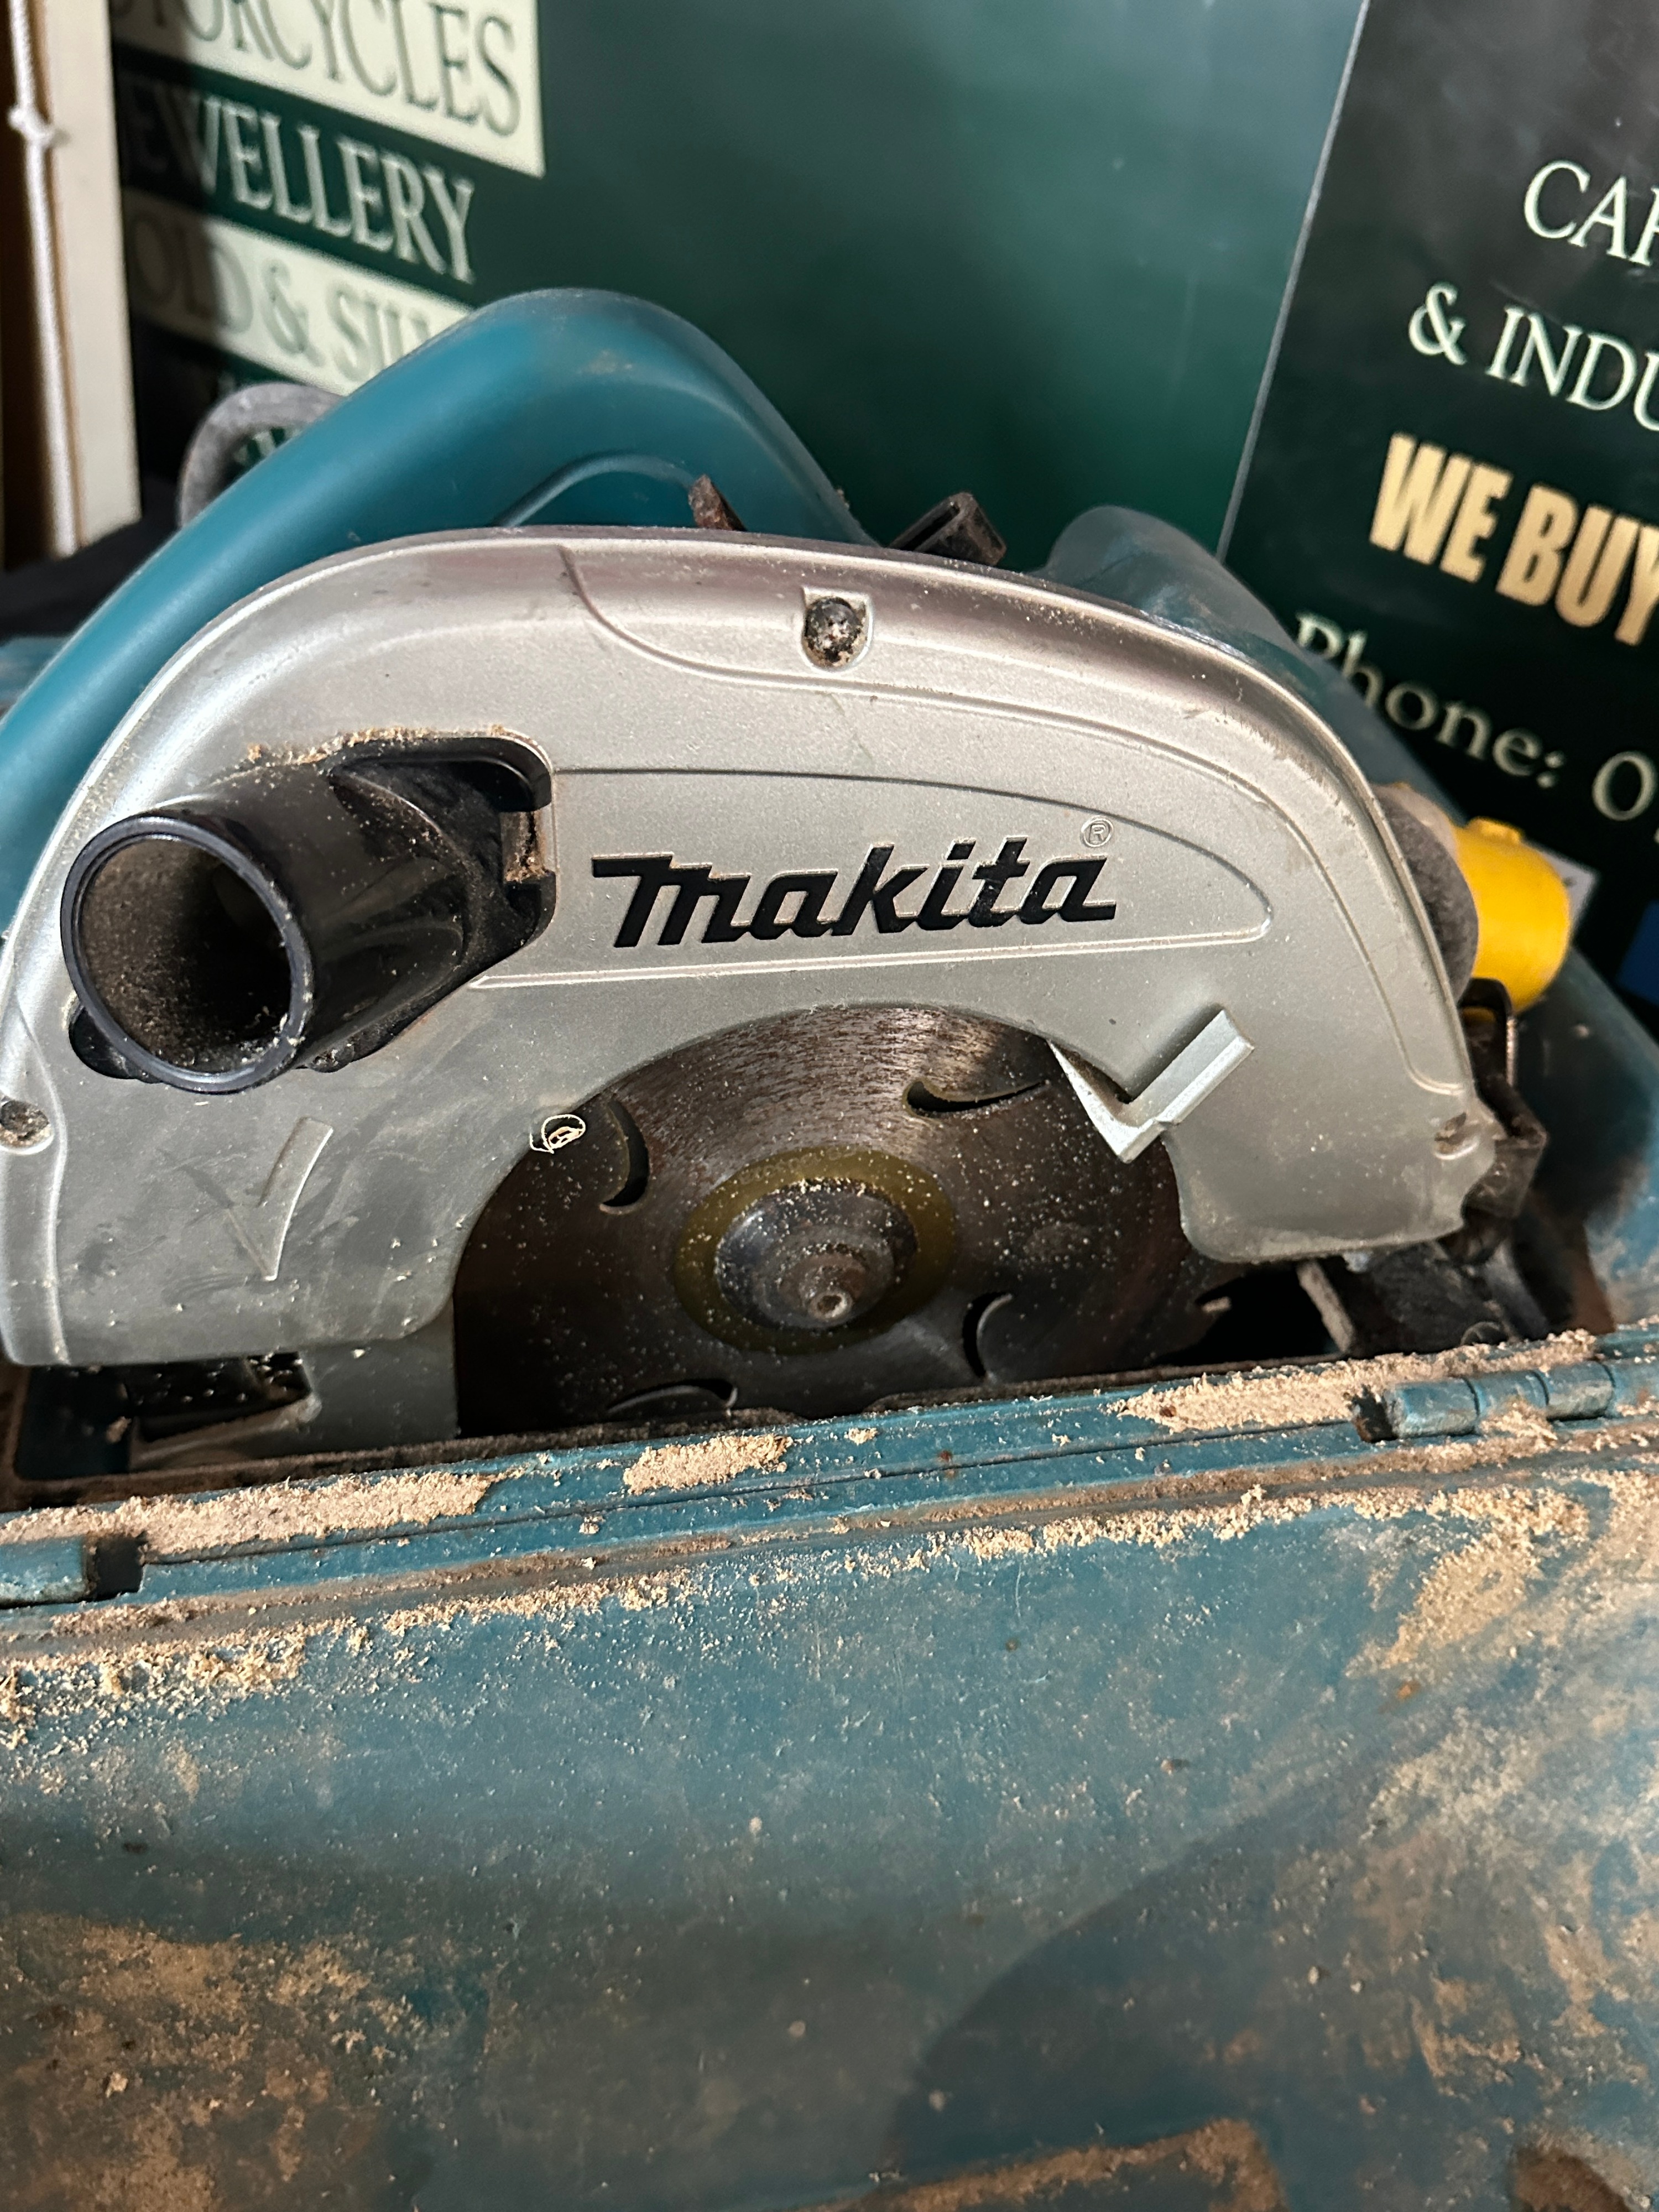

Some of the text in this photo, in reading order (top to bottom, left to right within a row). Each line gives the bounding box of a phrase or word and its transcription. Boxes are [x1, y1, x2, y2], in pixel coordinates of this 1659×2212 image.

[261, 257, 326, 367] &
[1408, 281, 1467, 366] &
[1369, 431, 1659, 647] WE BUY
[1295, 609, 1566, 789] Phone:
[591, 835, 1118, 948] makita
